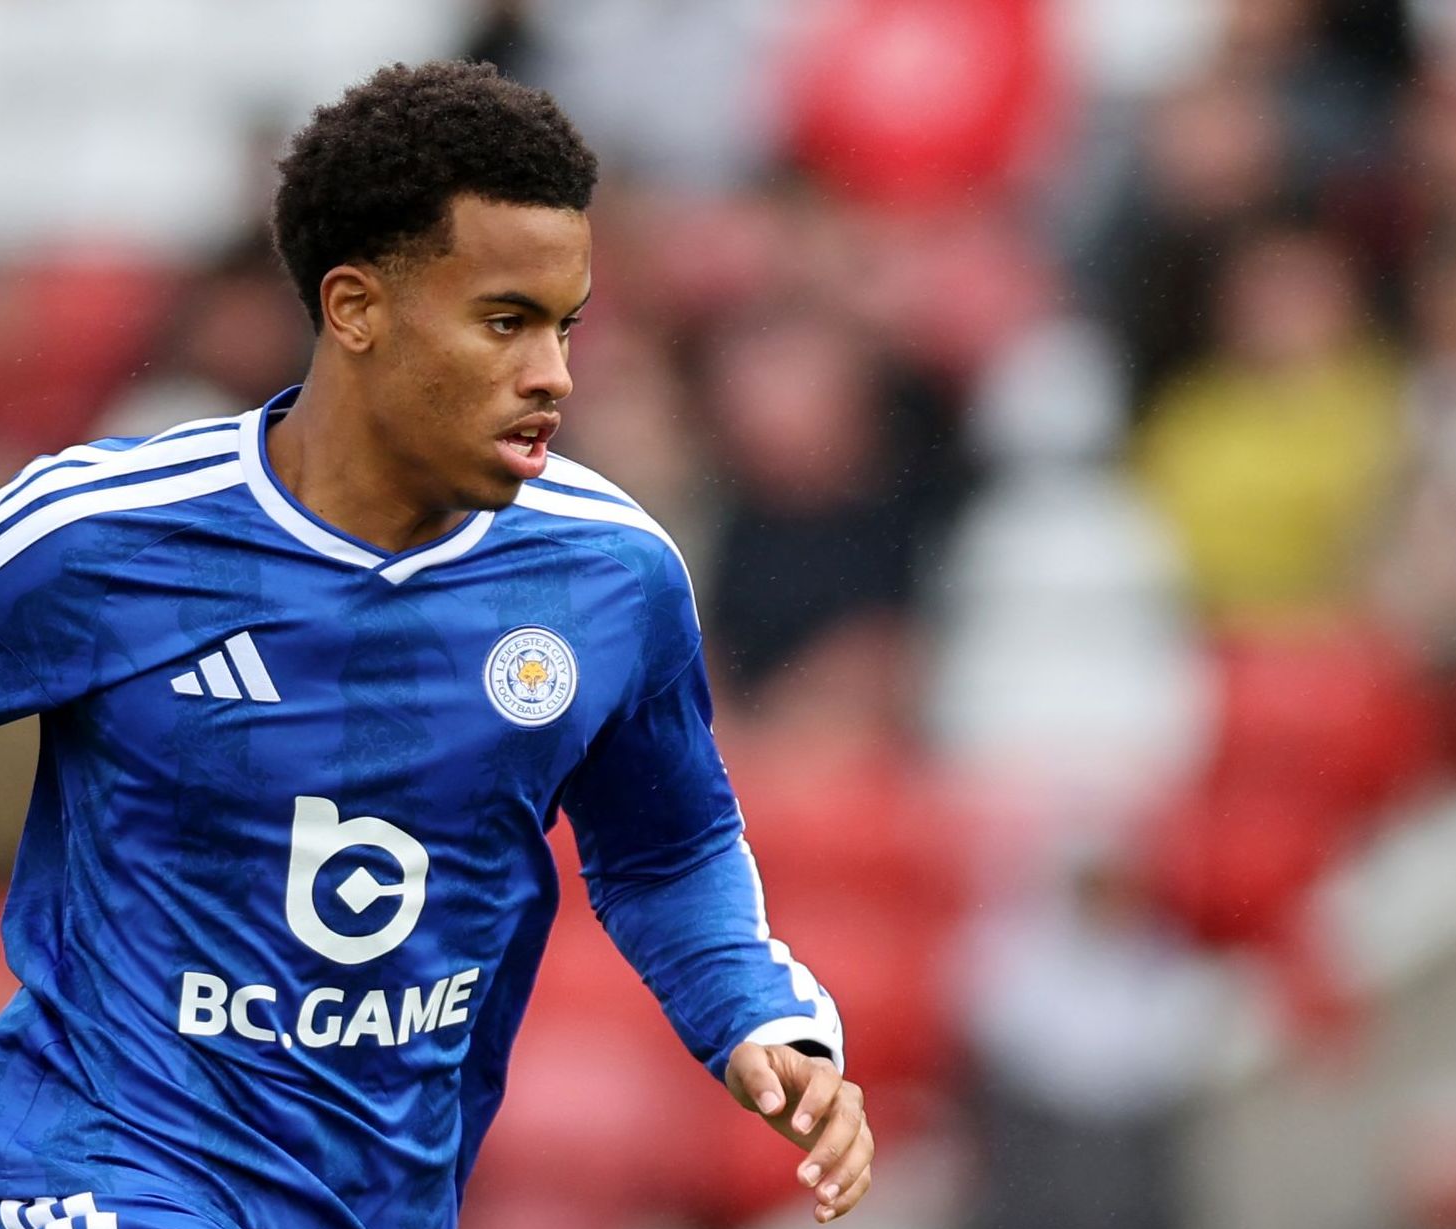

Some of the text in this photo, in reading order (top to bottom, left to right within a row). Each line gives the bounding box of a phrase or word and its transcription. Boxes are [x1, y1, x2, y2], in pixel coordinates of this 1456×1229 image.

[496, 638, 568, 675] LEICESTER CITY
[496, 679, 567, 715] FOOTBALL CLUB
[178, 967, 480, 1049] BC.GAME
